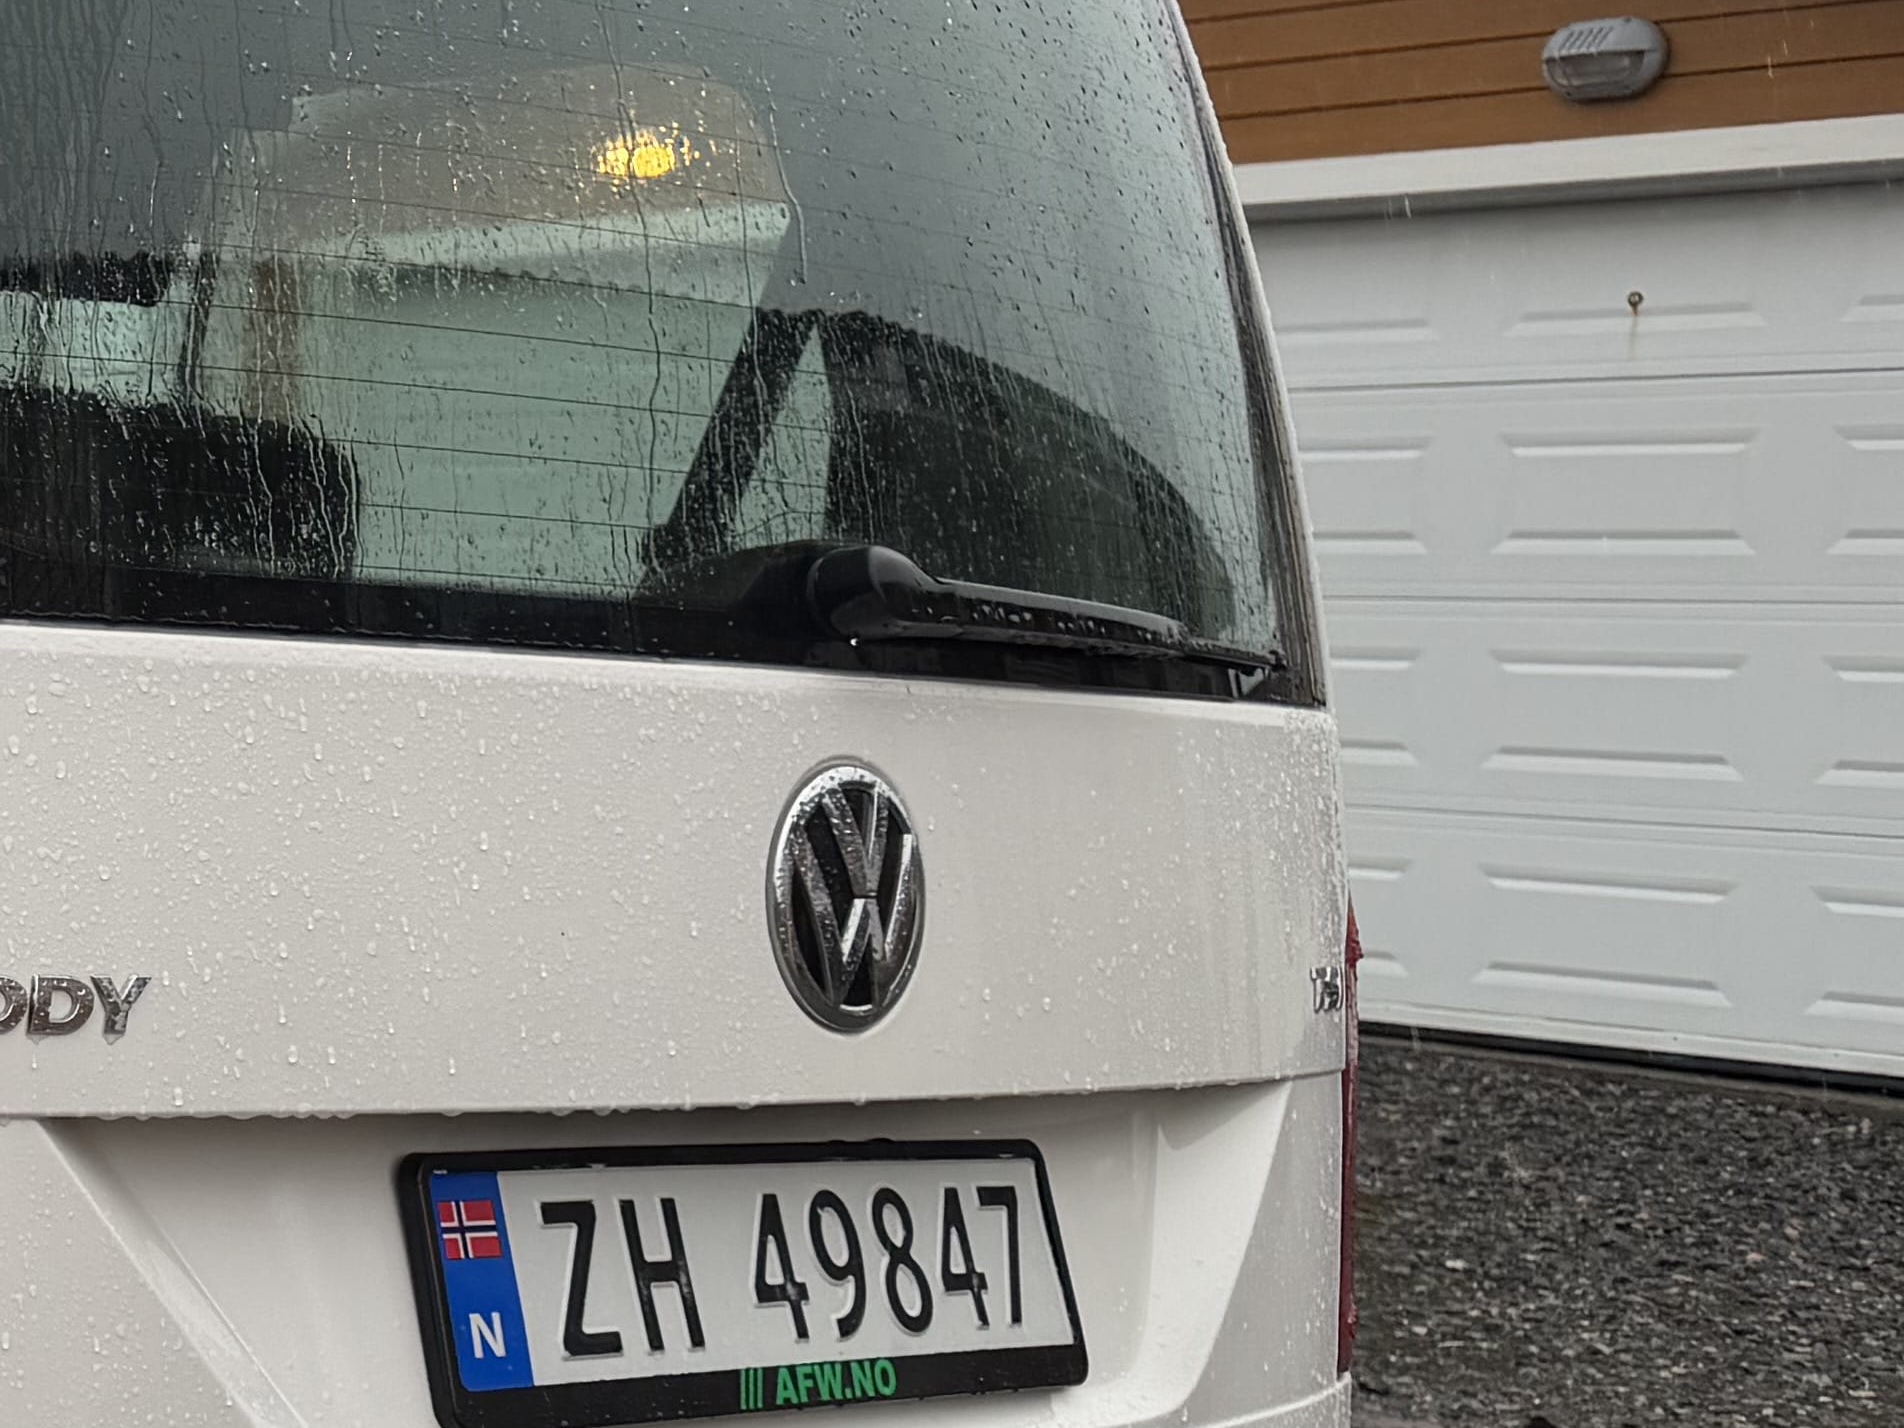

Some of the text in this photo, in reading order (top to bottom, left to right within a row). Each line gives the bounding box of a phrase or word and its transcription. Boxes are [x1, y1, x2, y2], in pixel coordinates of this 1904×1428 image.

[540, 1185, 1022, 1357] ZH 49847
[468, 1311, 508, 1360] N
[775, 1358, 897, 1406] AFW.NO
